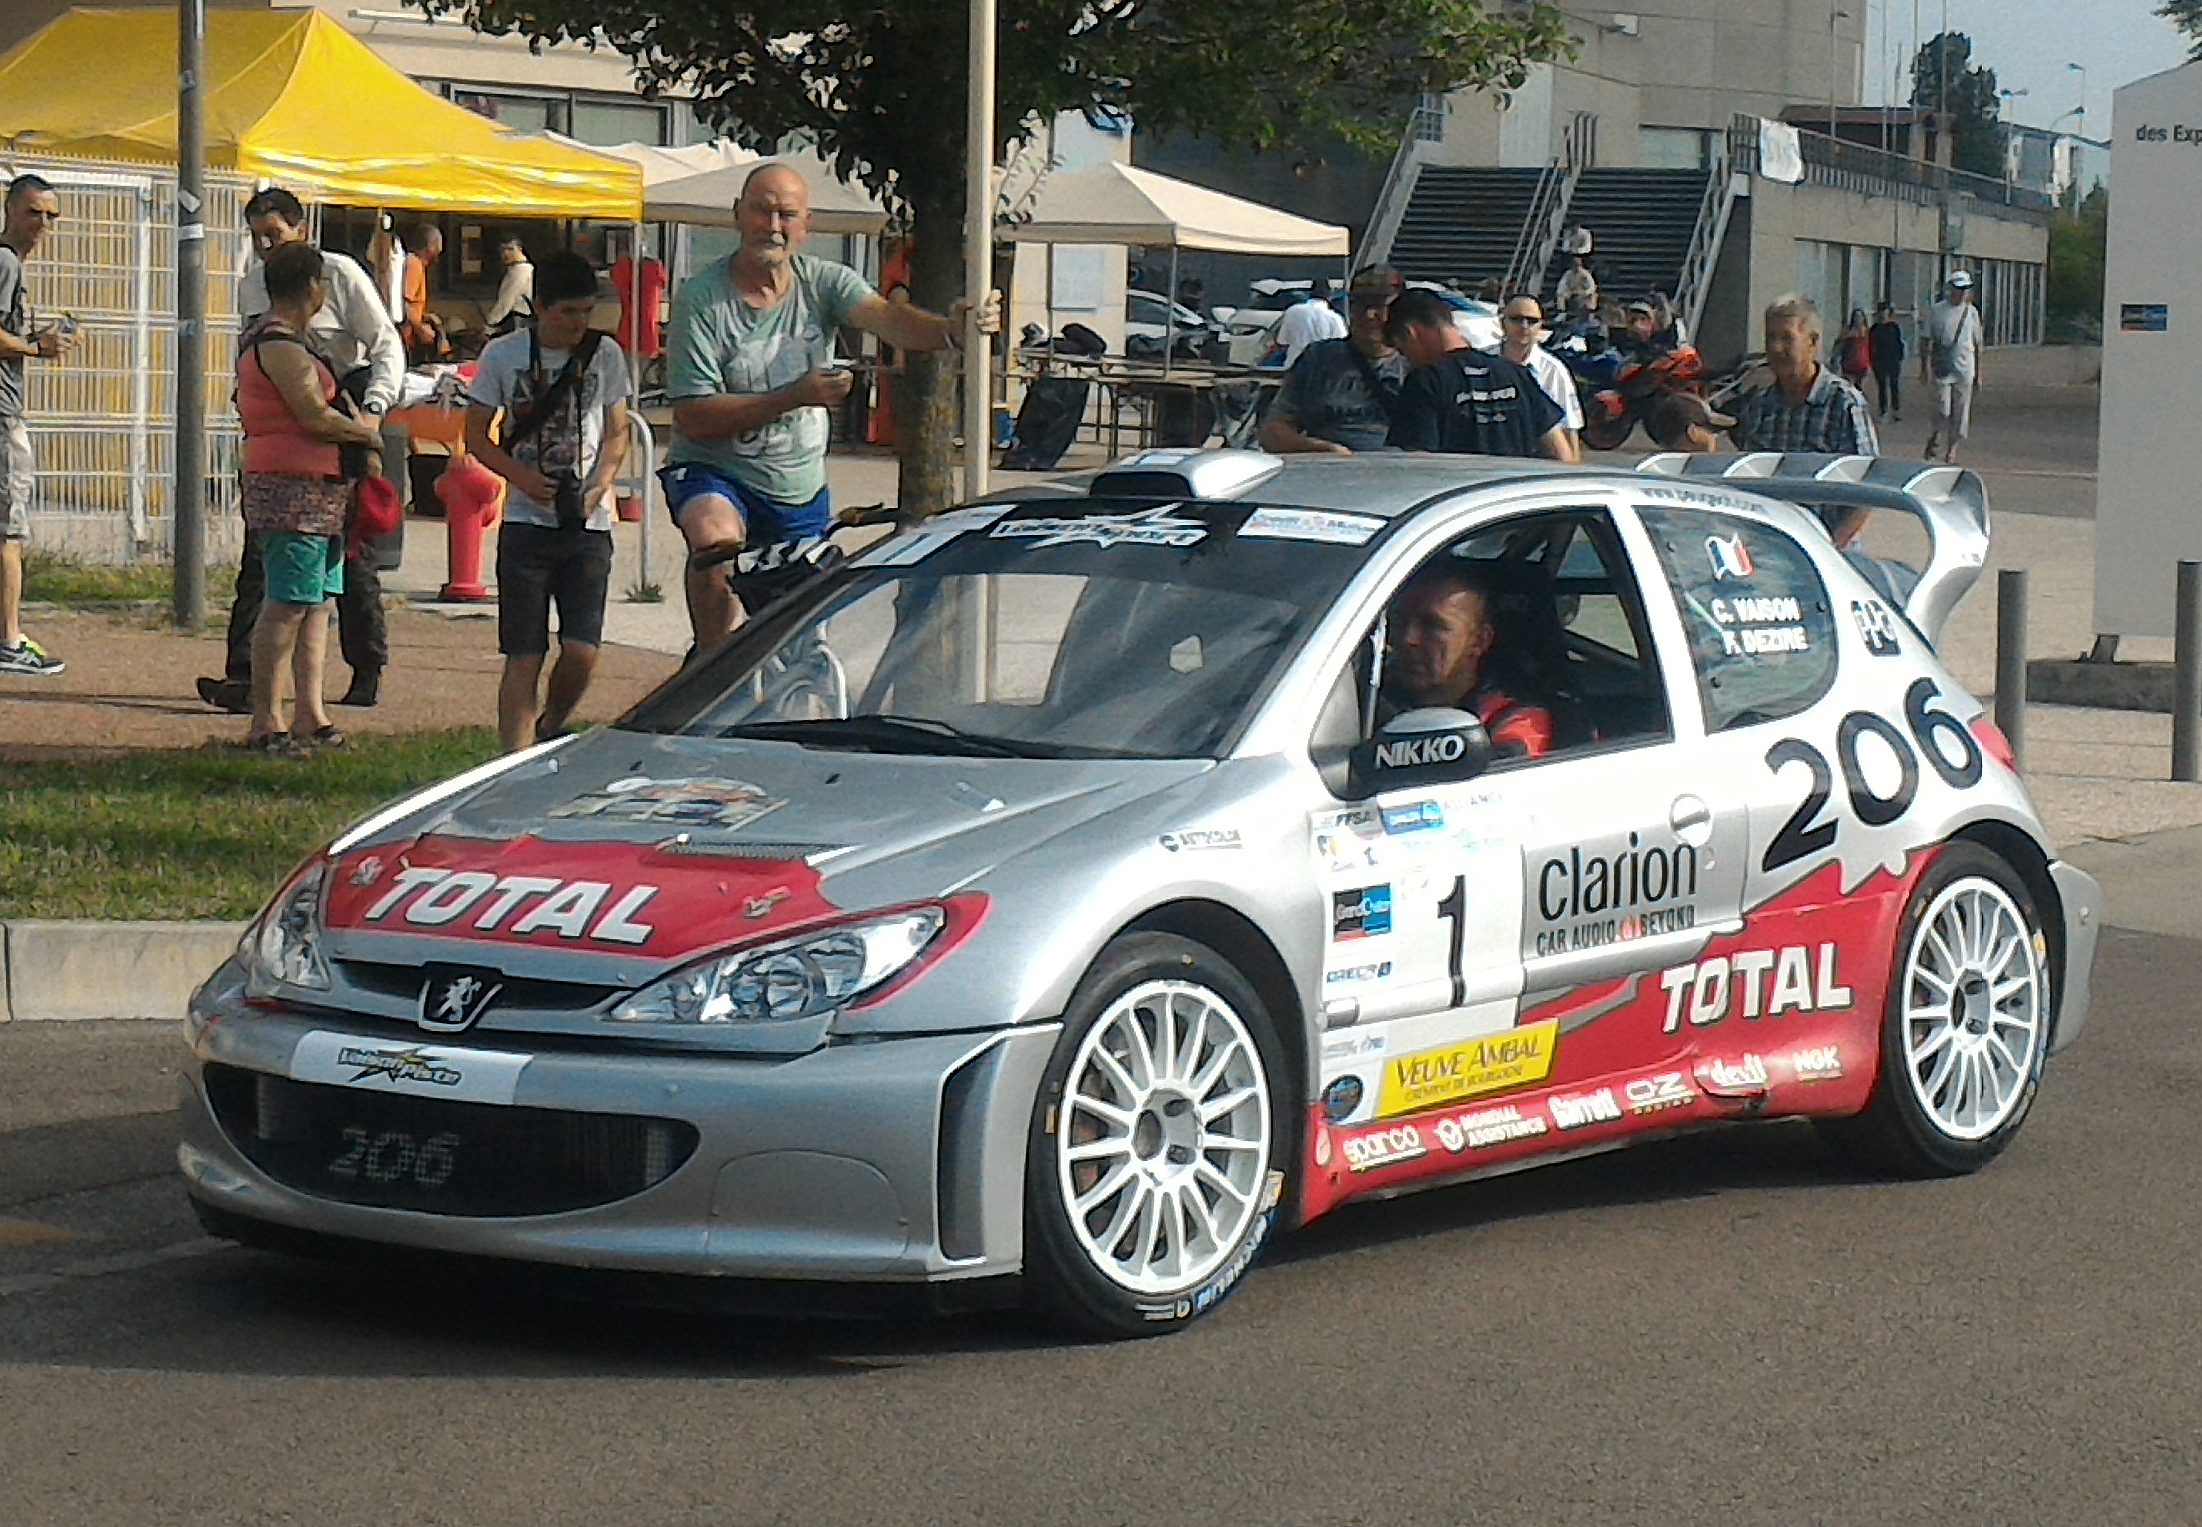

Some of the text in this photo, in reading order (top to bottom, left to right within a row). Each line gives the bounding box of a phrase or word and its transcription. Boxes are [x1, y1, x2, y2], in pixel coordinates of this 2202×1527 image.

[2135, 124, 2168, 142] des
[1711, 598, 1735, 623] C.
[1374, 733, 1466, 769] NIKKO
[1762, 677, 1983, 873] 206
[364, 866, 660, 946] TOTAL
[1437, 874, 1466, 1009] 1
[1537, 928, 1567, 957] CAR
[1571, 919, 1616, 950] AUDIO
[1660, 942, 1852, 1034] TOTAL
[1396, 1034, 1543, 1087] VEUVE AMBAL
[1793, 1045, 1841, 1073] NGK
[1626, 1072, 1688, 1101] OZ
[328, 1127, 460, 1184] 206
